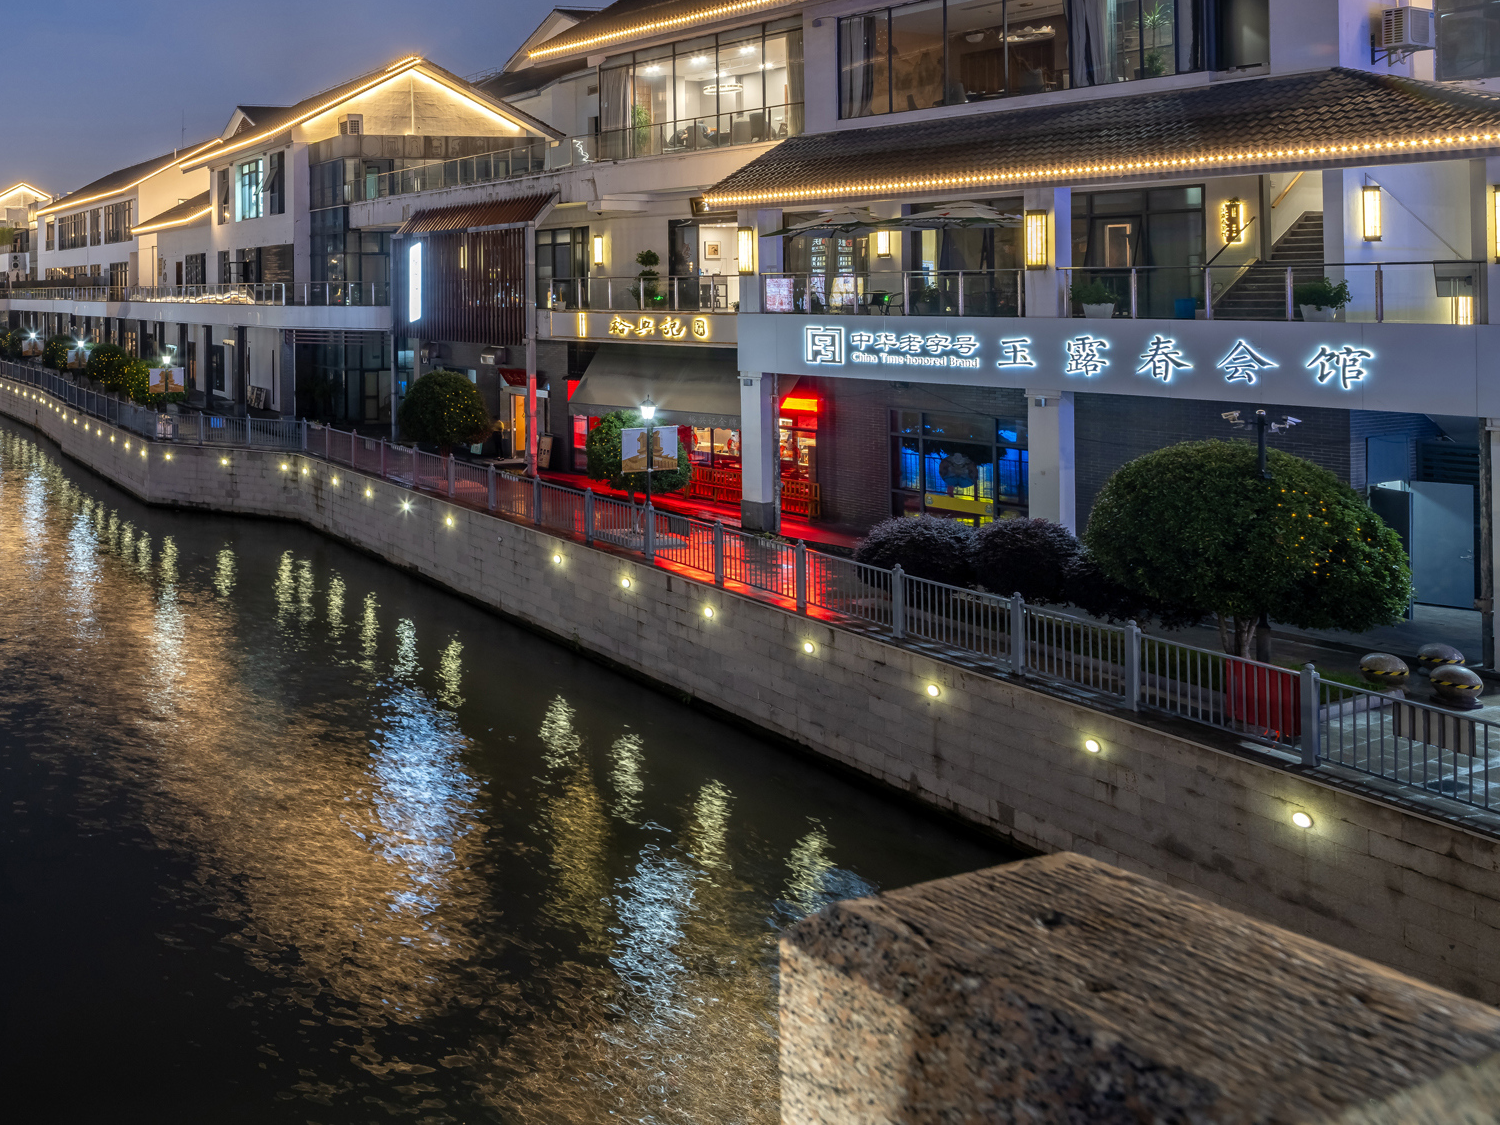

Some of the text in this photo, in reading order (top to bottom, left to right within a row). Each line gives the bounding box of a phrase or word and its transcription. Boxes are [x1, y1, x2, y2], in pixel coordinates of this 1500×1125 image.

[851, 332, 980, 356] 中华老字号
[851, 352, 878, 364] China
[950, 356, 980, 368] Brand
[997, 334, 1375, 390] 玉露春会馆
